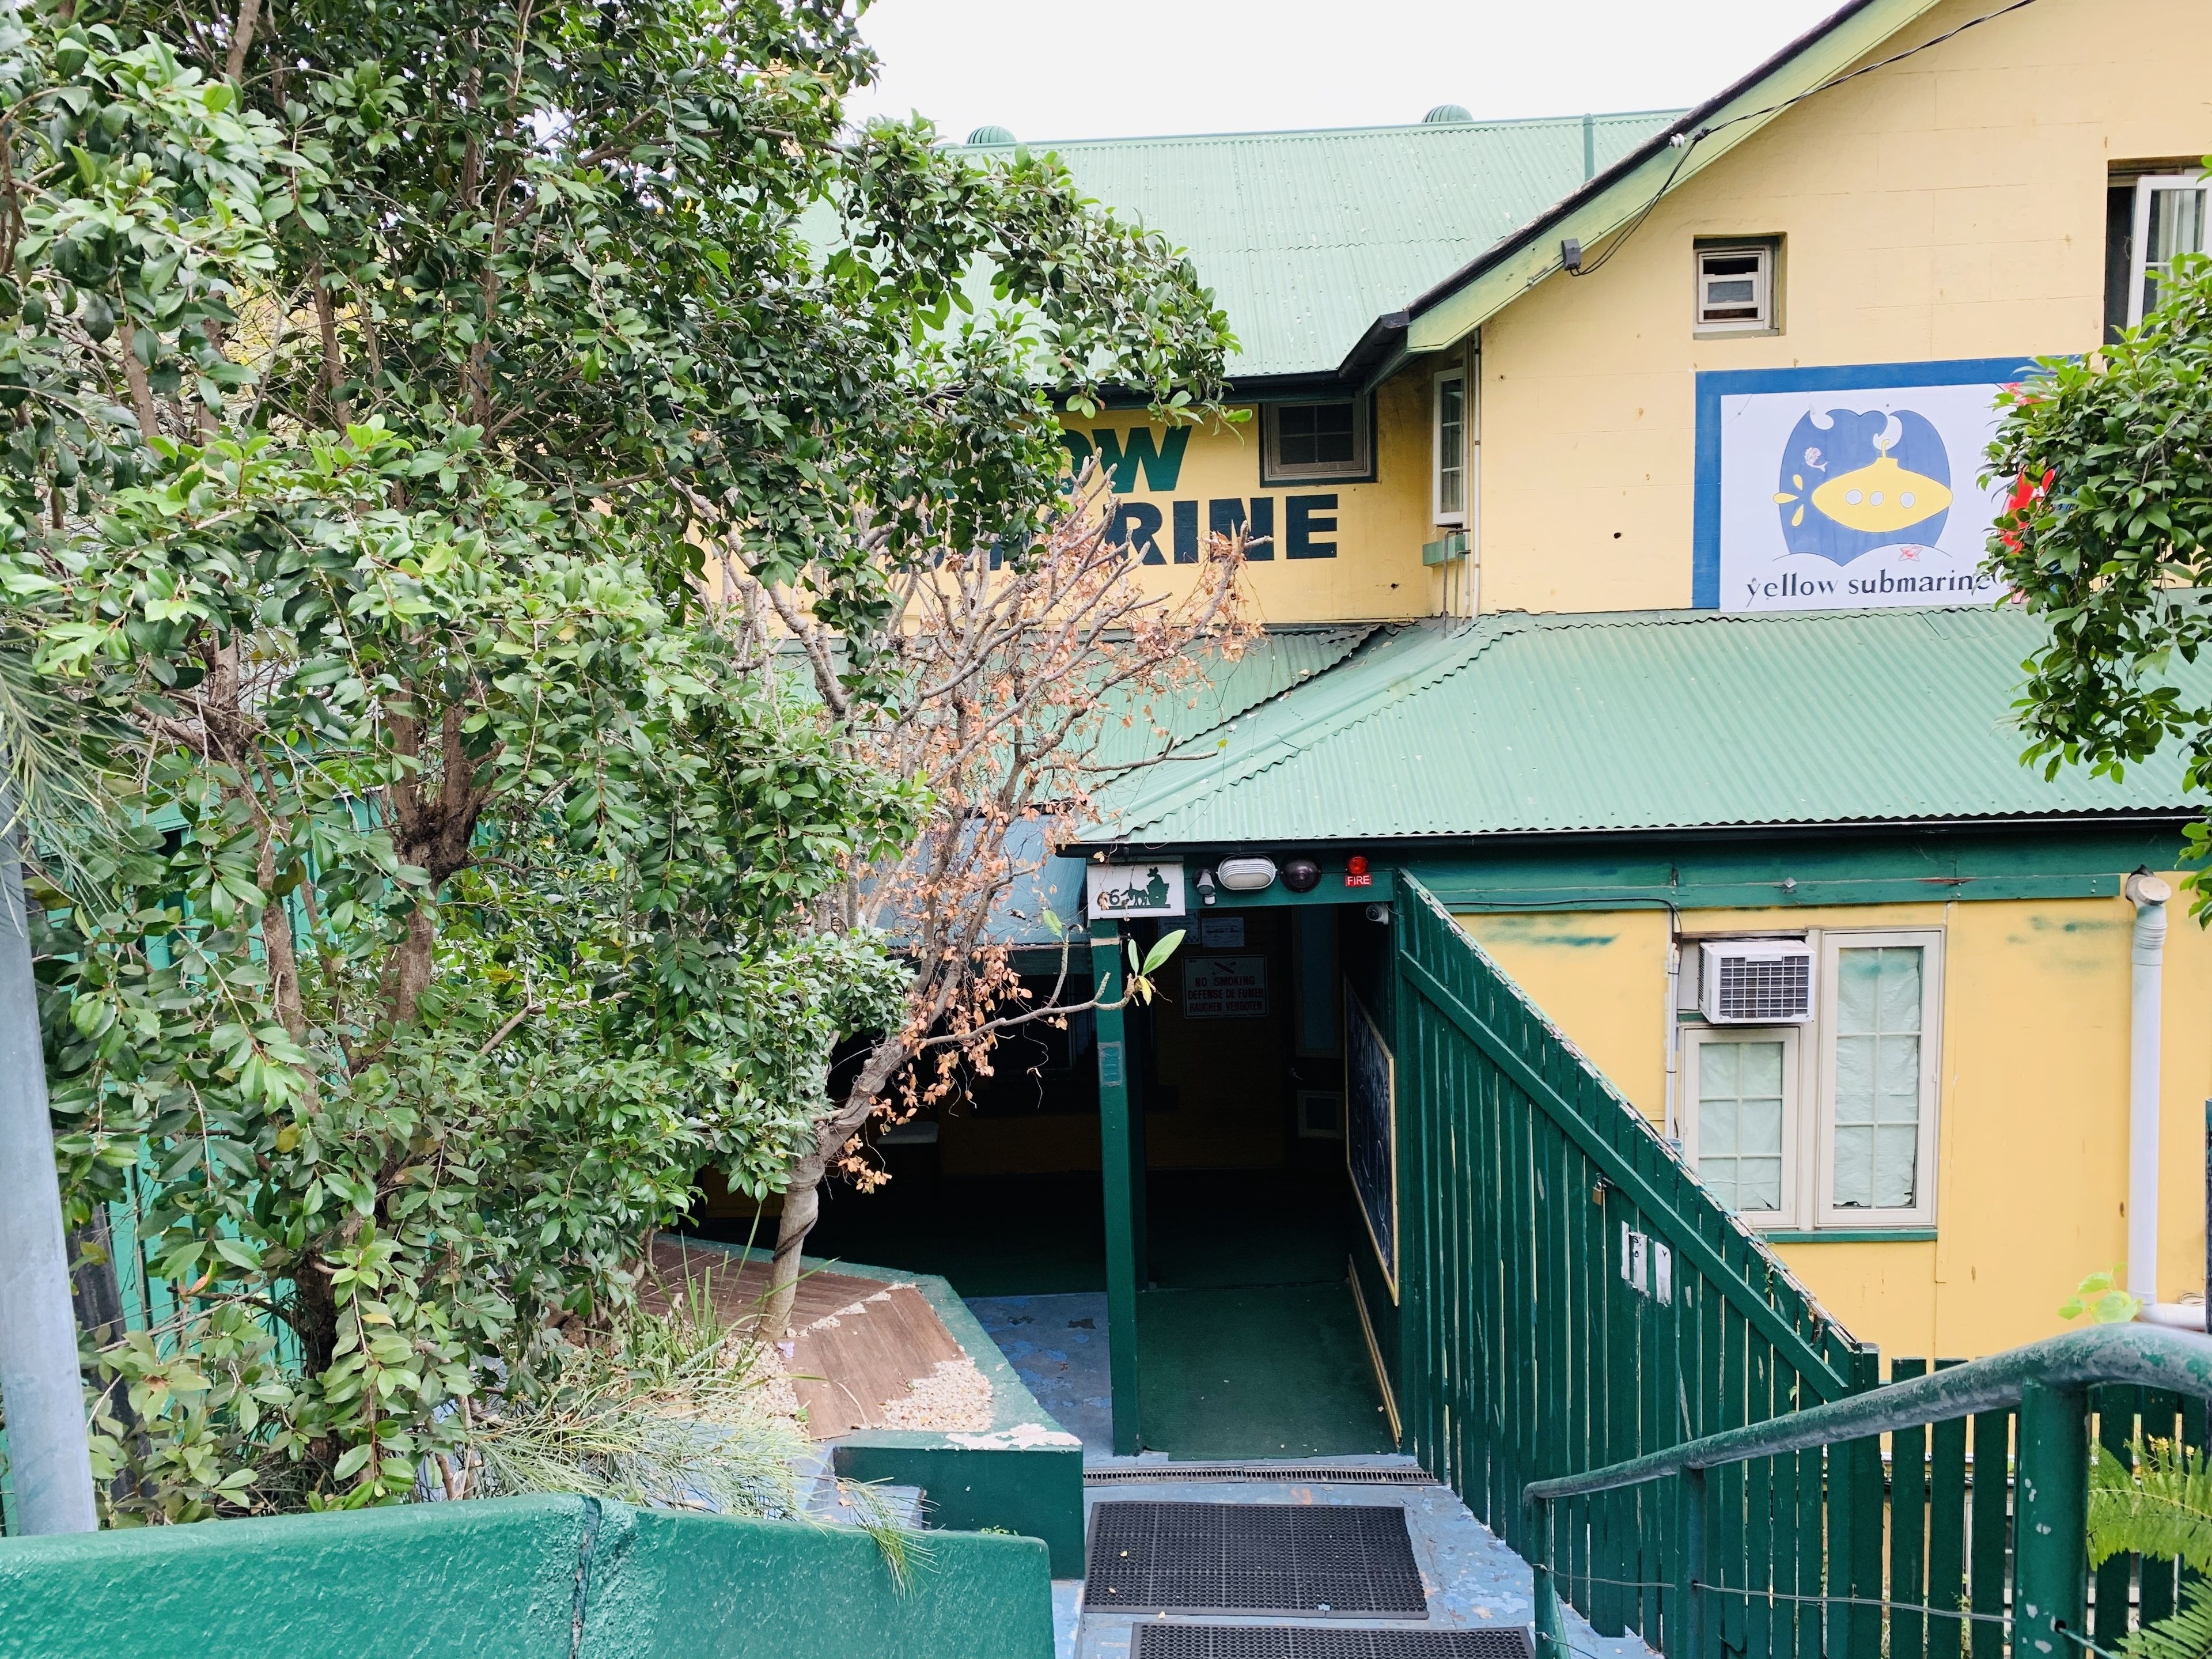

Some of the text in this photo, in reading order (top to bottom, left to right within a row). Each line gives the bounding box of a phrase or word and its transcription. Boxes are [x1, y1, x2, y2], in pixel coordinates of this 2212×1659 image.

[1747, 569, 1990, 608] yellow submarine
[1347, 875, 1370, 885] FIRE
[1195, 976, 1255, 987] NO SMOKING
[1188, 988, 1263, 999] DEFENSE DE FUMER
[1190, 1001, 1263, 1012] RAUCHEN VERBOTEN
